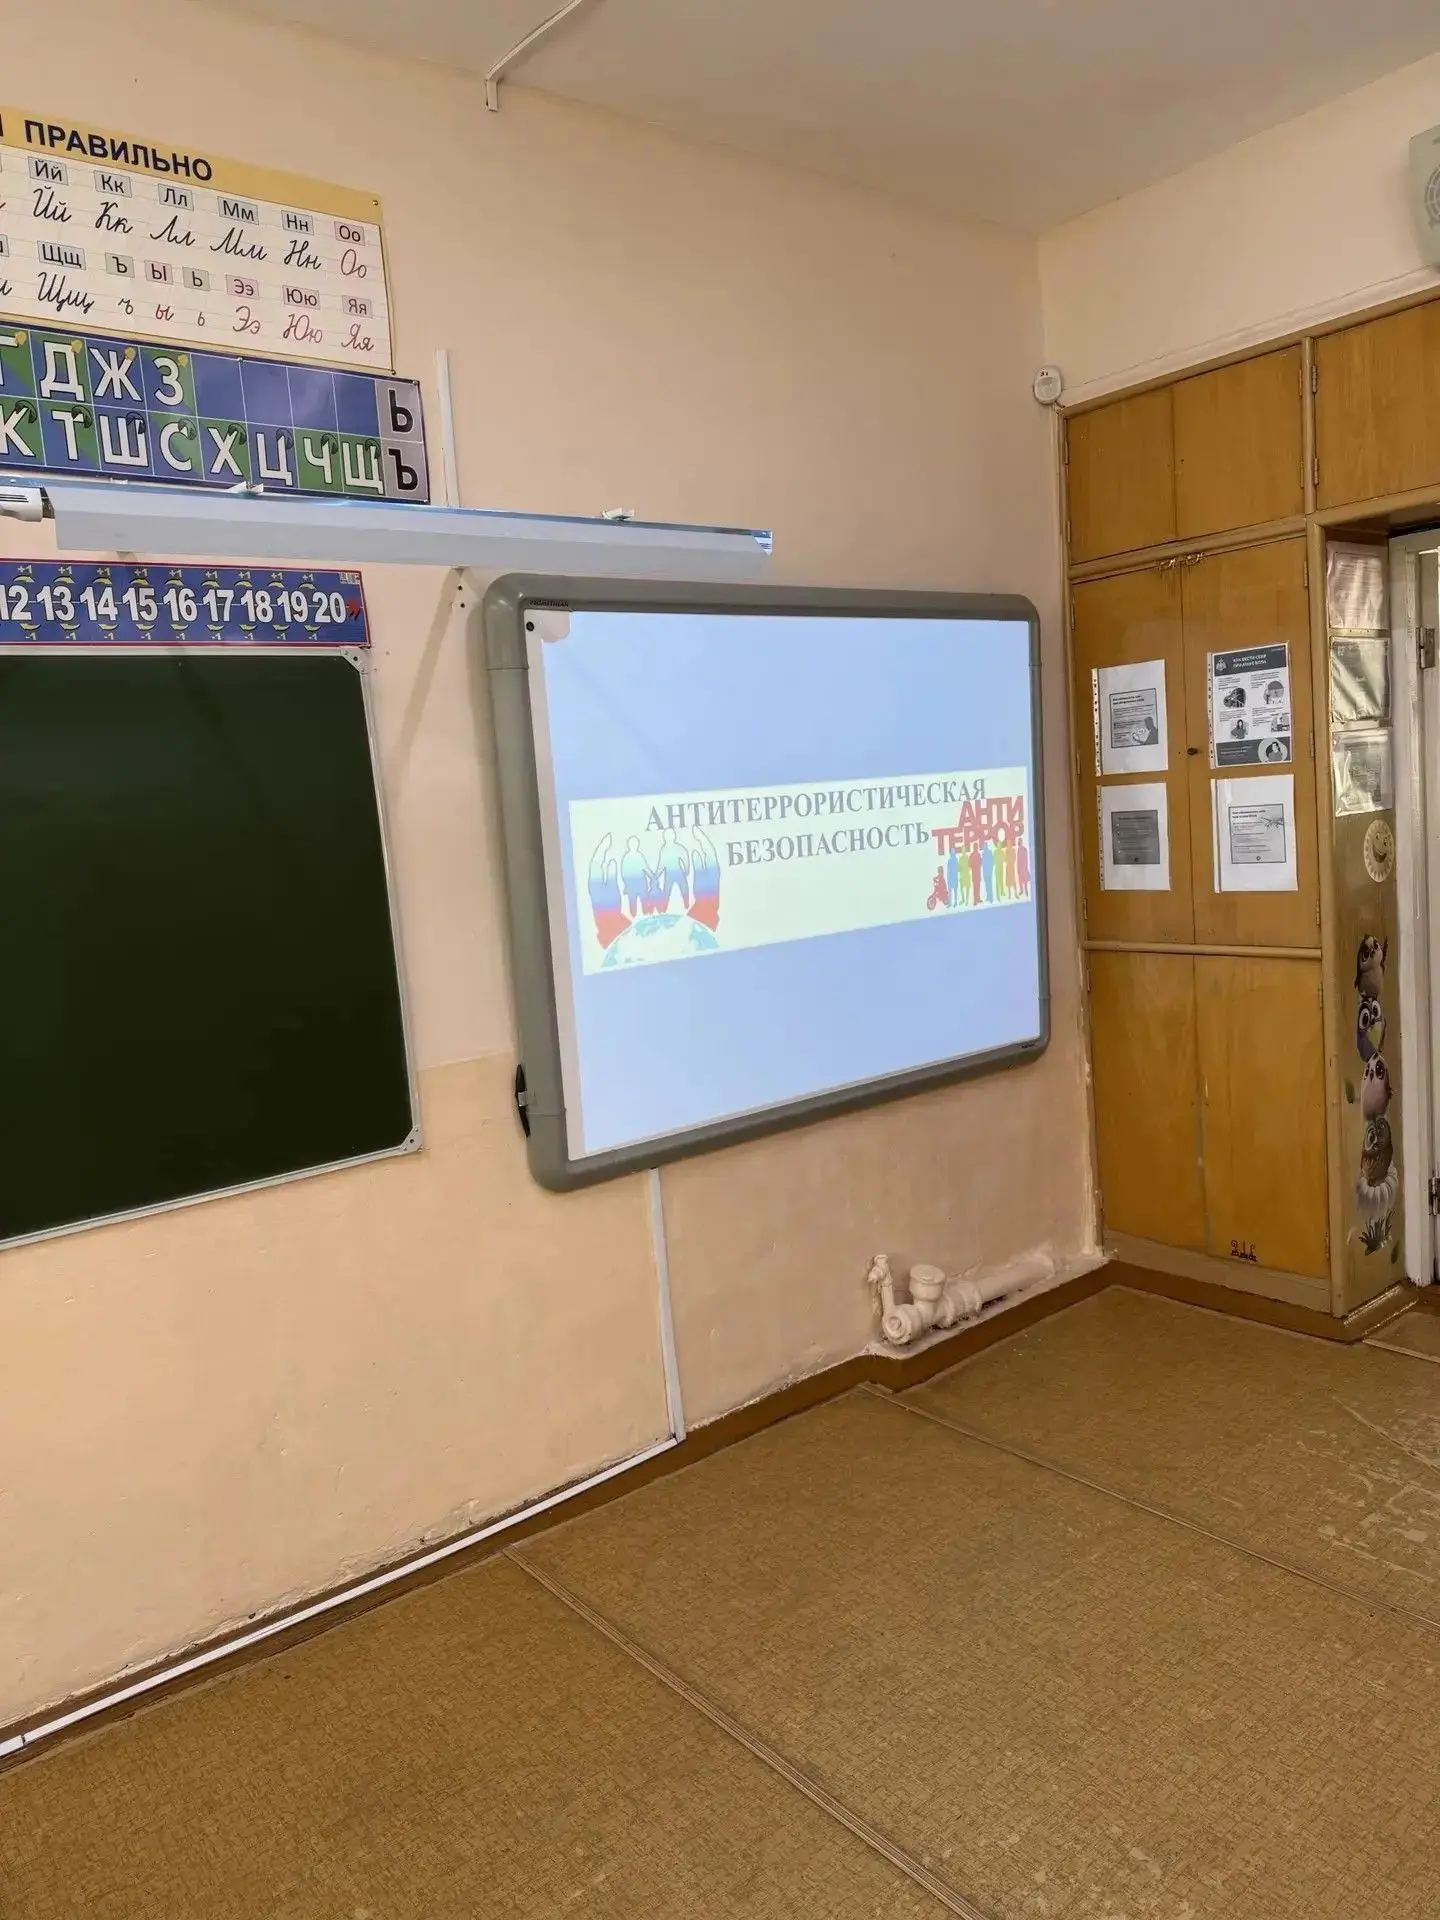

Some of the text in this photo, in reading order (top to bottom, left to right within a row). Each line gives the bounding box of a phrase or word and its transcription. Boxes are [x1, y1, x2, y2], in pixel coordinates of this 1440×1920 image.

[24, 119, 212, 181] ПРАВИЛЬНО
[34, 159, 361, 242] Йй Кк Лл Мм Нн Оо
[33, 185, 367, 279] Йй Кк Лл Мм Нн Оо
[42, 243, 82, 268] Щщ
[233, 278, 254, 296] Ээ
[286, 288, 318, 307] Юю
[348, 298, 367, 316] Яя
[232, 305, 261, 335] Ээ
[283, 313, 323, 344] Юю
[341, 323, 374, 351] Яя
[40, 341, 86, 402] Д
[87, 347, 143, 402] Ж
[389, 389, 414, 433] Ь
[0, 404, 419, 495] К Т Ш С Х Ц Ч Щ Ъ
[36, 585, 75, 621] 13
[79, 586, 118, 621] 14
[122, 587, 158, 622] 15
[163, 588, 198, 622] 16
[202, 588, 235, 622] 17
[240, 589, 274, 623] 18
[276, 590, 309, 623] 19
[312, 591, 347, 624] 20
[645, 777, 986, 832] АНТИТЕРРОРИСТИЧЕСКАЯ
[957, 795, 1025, 829] АНТИ
[727, 821, 930, 867] БЕЗОПАСНОСТЬ
[931, 820, 1025, 857] ТЕРРОР
